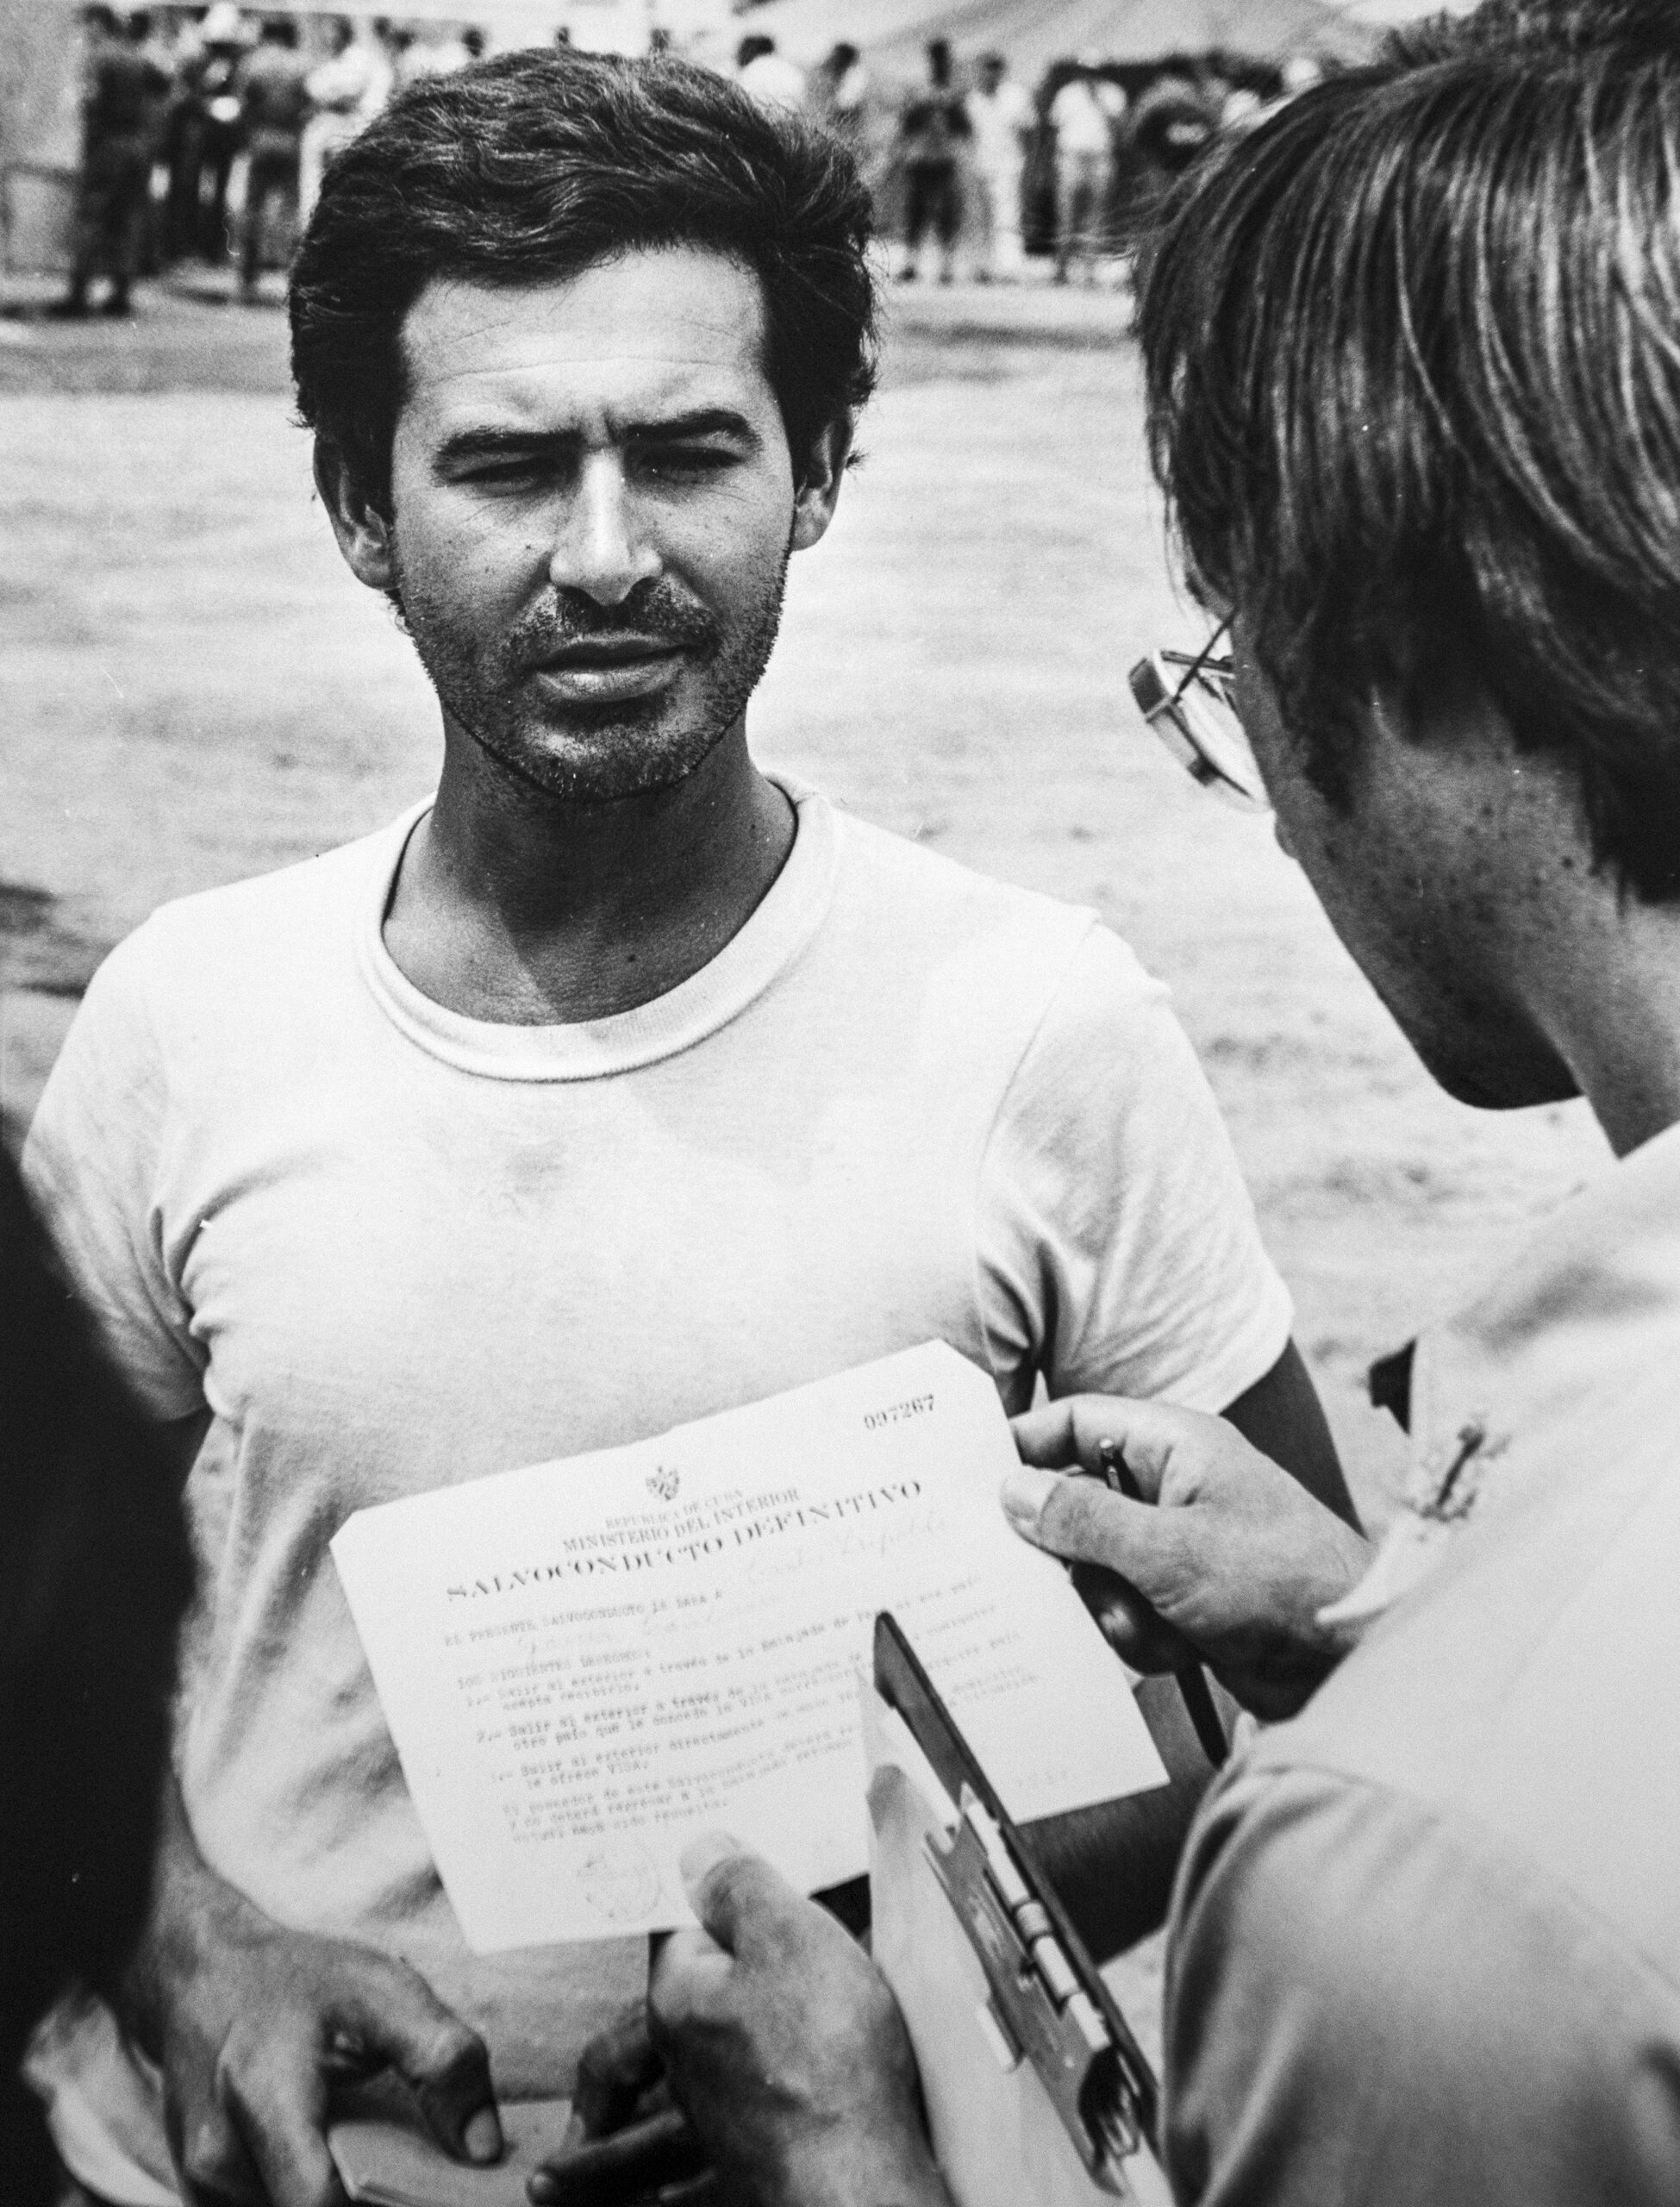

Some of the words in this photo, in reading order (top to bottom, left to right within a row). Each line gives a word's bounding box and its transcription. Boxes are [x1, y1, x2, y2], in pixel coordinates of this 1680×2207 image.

[863, 1393, 934, 1430] 097267
[562, 1526, 671, 1553] MINISTERIO
[675, 1515, 711, 1539] DEL
[714, 1487, 802, 1525] INTERIOR
[447, 1536, 724, 1603] SALVOCONDUCTO
[734, 1479, 921, 1547] DEFINITIVO
[469, 1618, 538, 1642] PRESENTE
[542, 1603, 646, 1627] SALVOCONDUCTO
[571, 1669, 634, 1687] exterior
[509, 1720, 552, 1737] Salir
[583, 1702, 647, 1723] exterior
[521, 1760, 561, 1777] Salir
[596, 1742, 659, 1763] exterior
